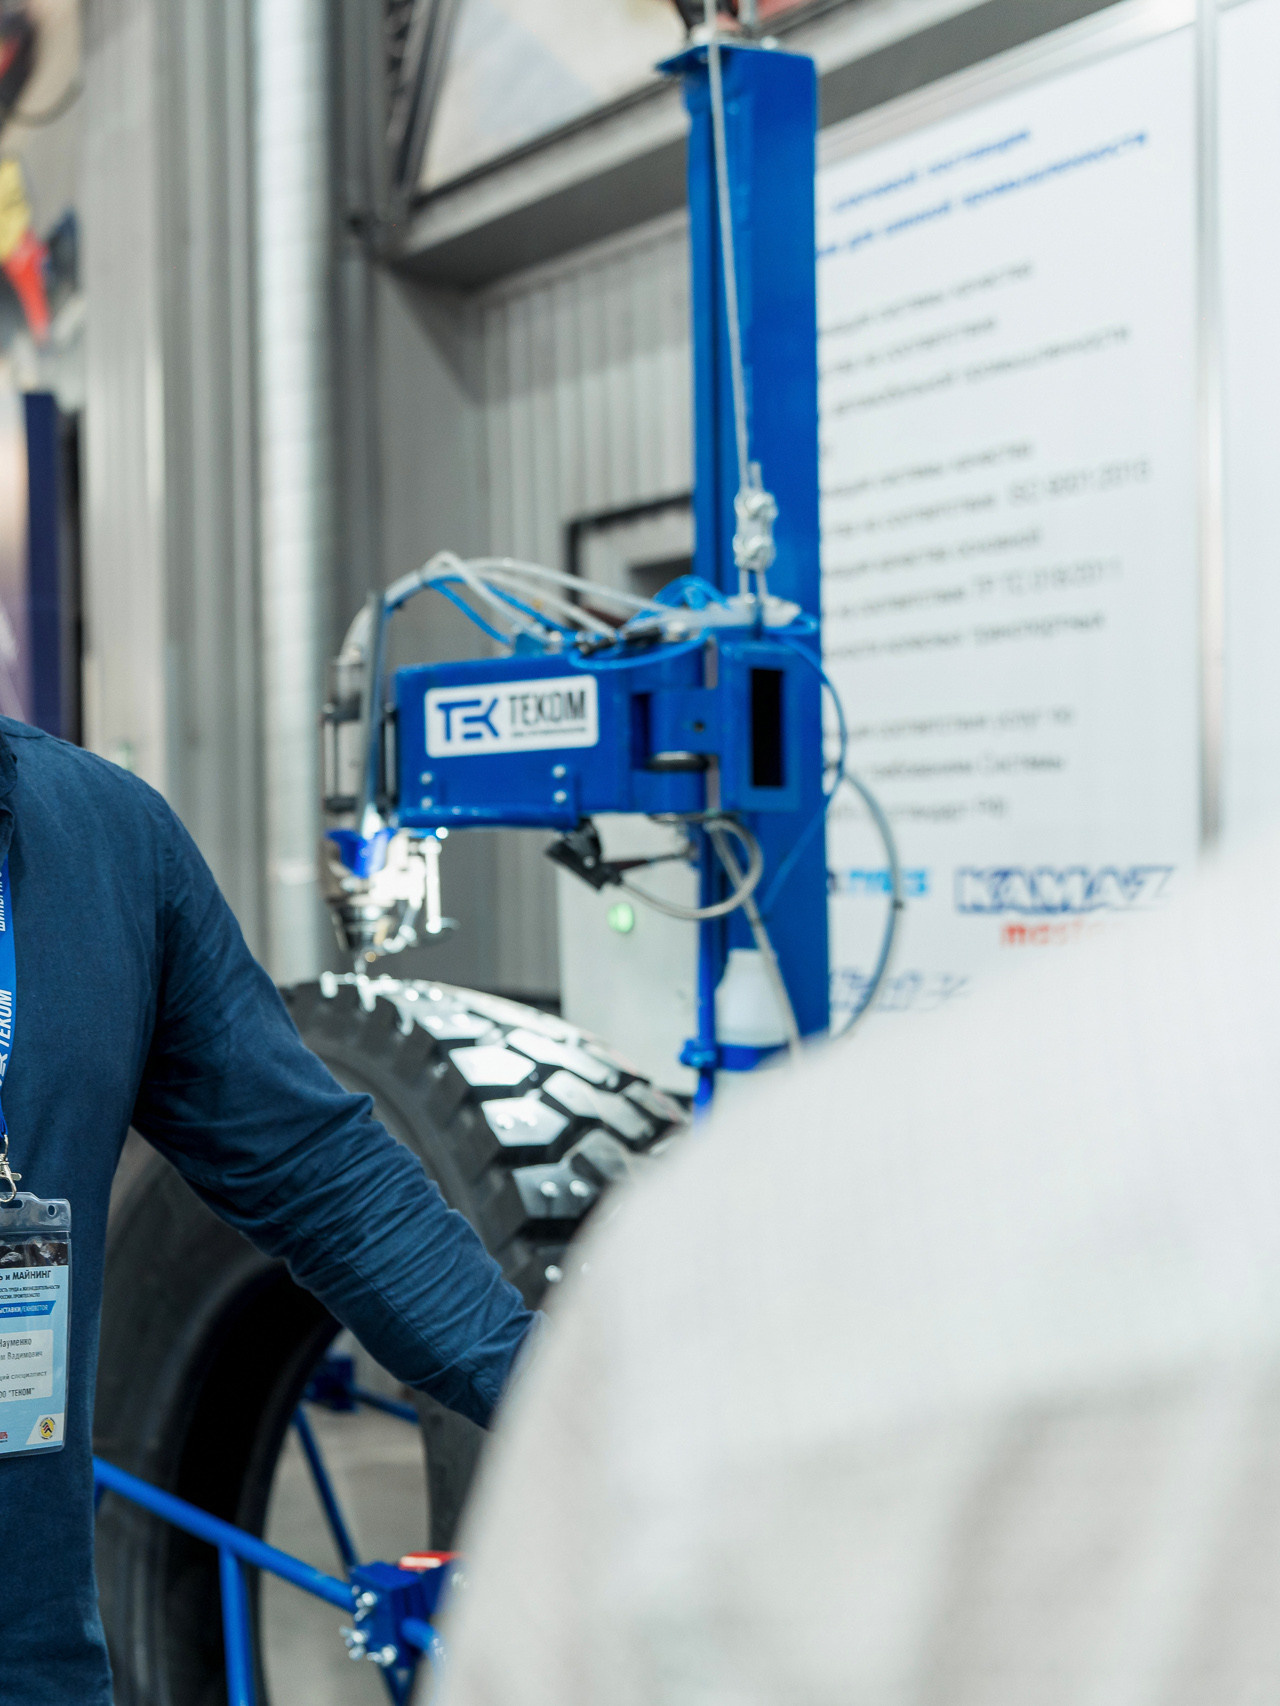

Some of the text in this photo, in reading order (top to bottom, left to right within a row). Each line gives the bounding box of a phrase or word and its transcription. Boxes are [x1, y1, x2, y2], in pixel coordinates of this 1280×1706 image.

[509, 690, 585, 725] ТЕКОМ
[954, 865, 1176, 914] KAMAZ
[12, 1270, 52, 1281] МАЙНИНГ
